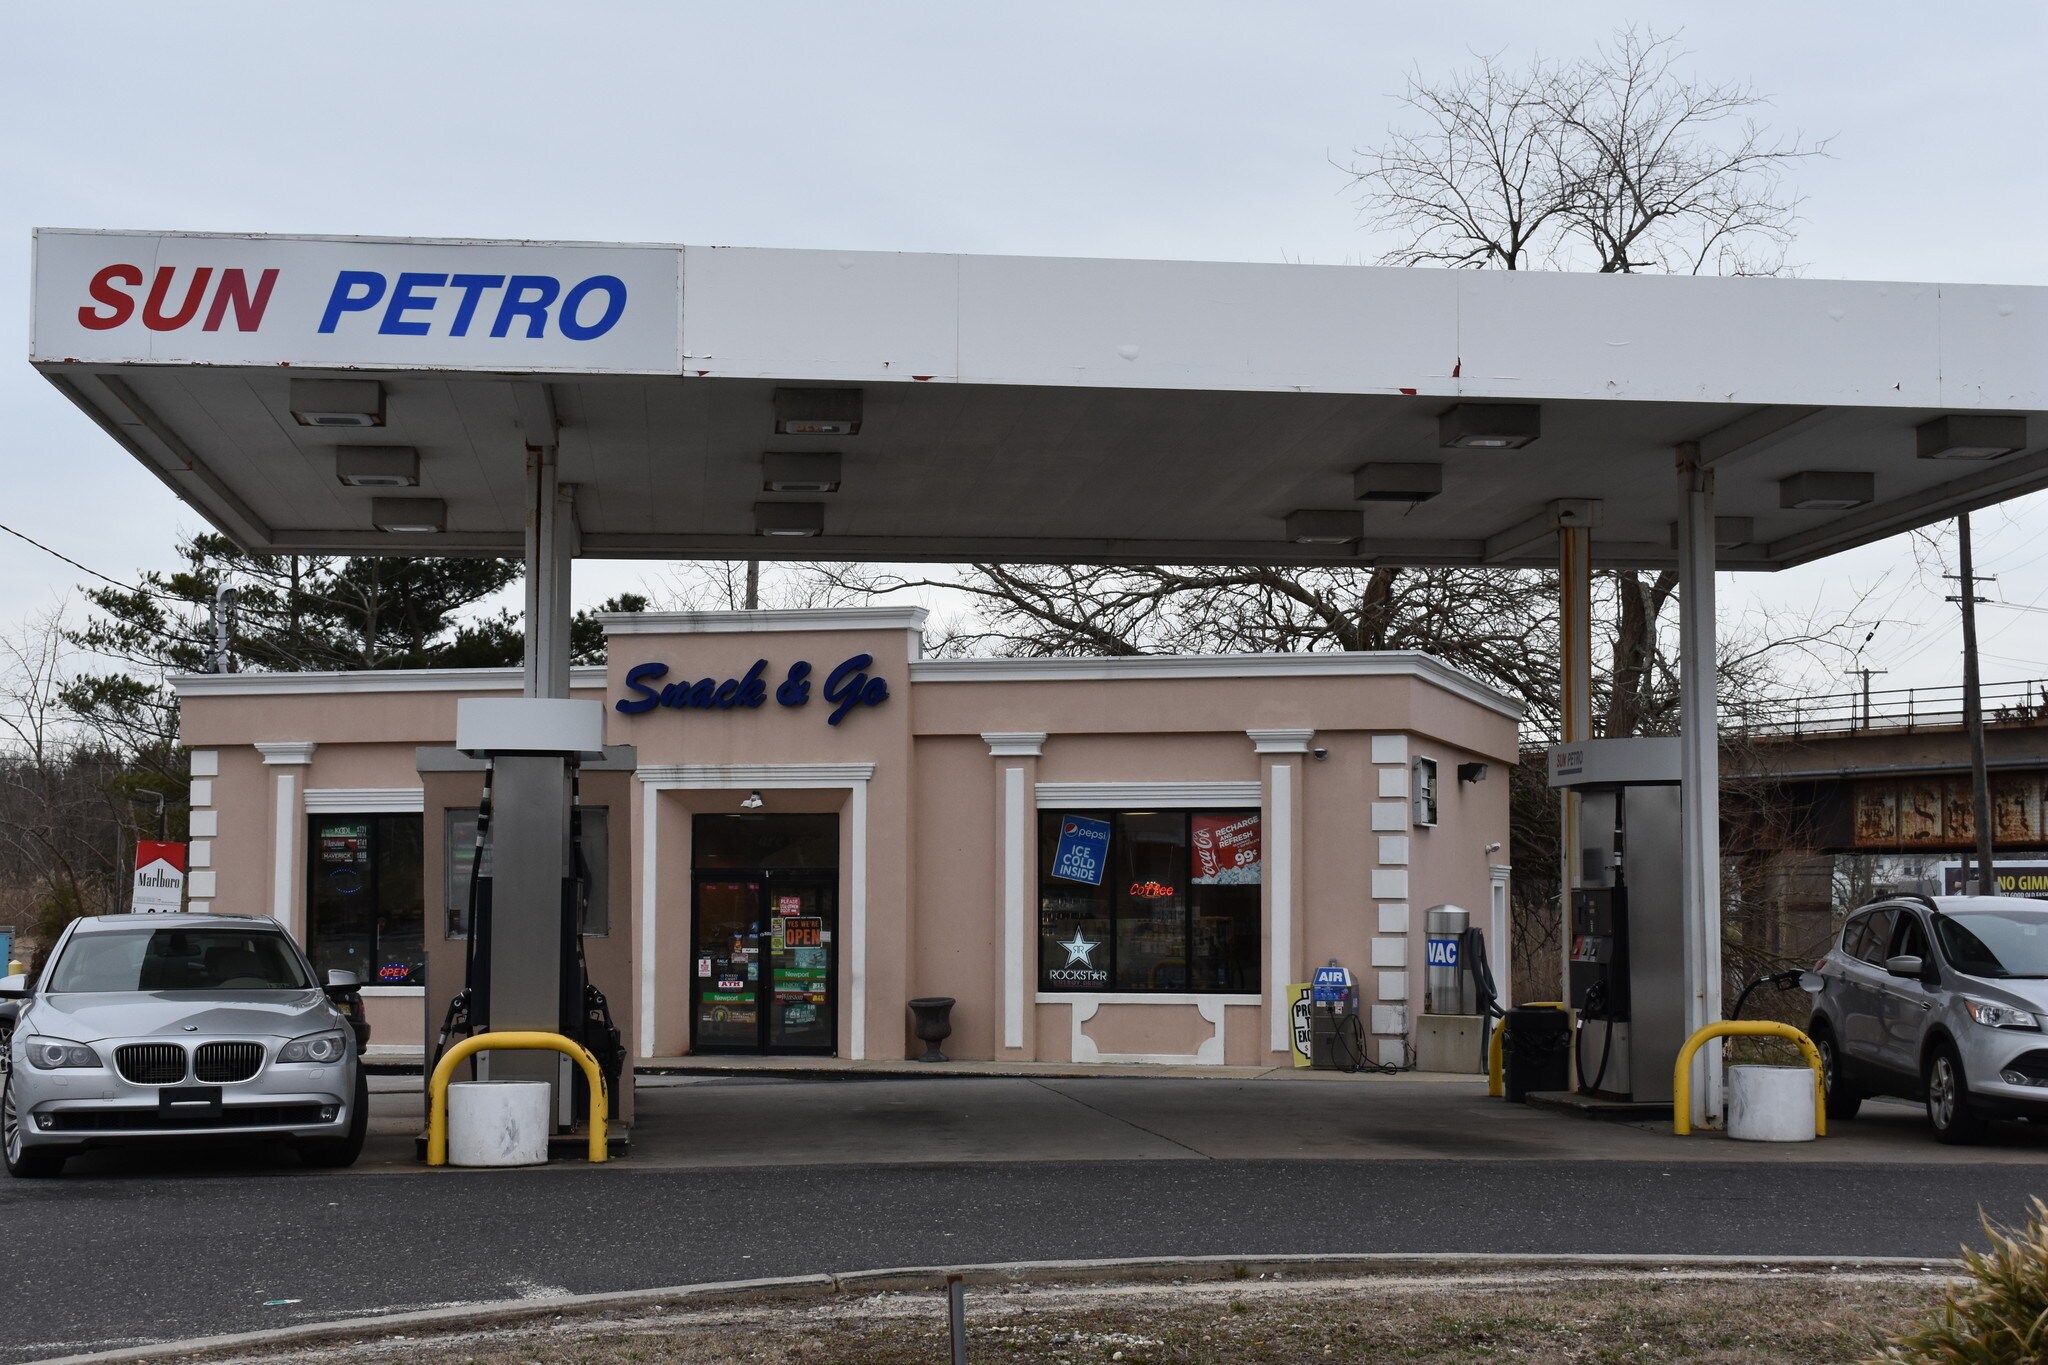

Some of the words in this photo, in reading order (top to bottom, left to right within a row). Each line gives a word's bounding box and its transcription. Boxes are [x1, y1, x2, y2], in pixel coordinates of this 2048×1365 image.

[77, 263, 280, 333] SUN
[317, 269, 628, 342] PETRO
[615, 658, 769, 715] Snack
[775, 660, 812, 708] &
[822, 653, 890, 727] Go
[1557, 753, 1566, 767] SUN
[1568, 751, 1583, 766] PETRO
[335, 827, 351, 835] KOOL
[1078, 828, 1107, 840] pepsi
[1215, 815, 1260, 837] RECHARGE
[1219, 830, 1254, 849] REFRESH
[1220, 832, 1233, 842] AND
[1071, 844, 1091, 859] ICE
[1192, 827, 1216, 876] oca-Co
[1062, 853, 1096, 870] COLD
[138, 868, 180, 889] Marlboro
[1059, 863, 1096, 881] INSIDE
[1130, 884, 1173, 896] Coffee
[1998, 876, 2015, 890] NO
[786, 929, 820, 945] OPEN
[1428, 943, 1456, 963] VAC
[380, 968, 408, 976] OPEN
[1319, 972, 1342, 982] AIR
